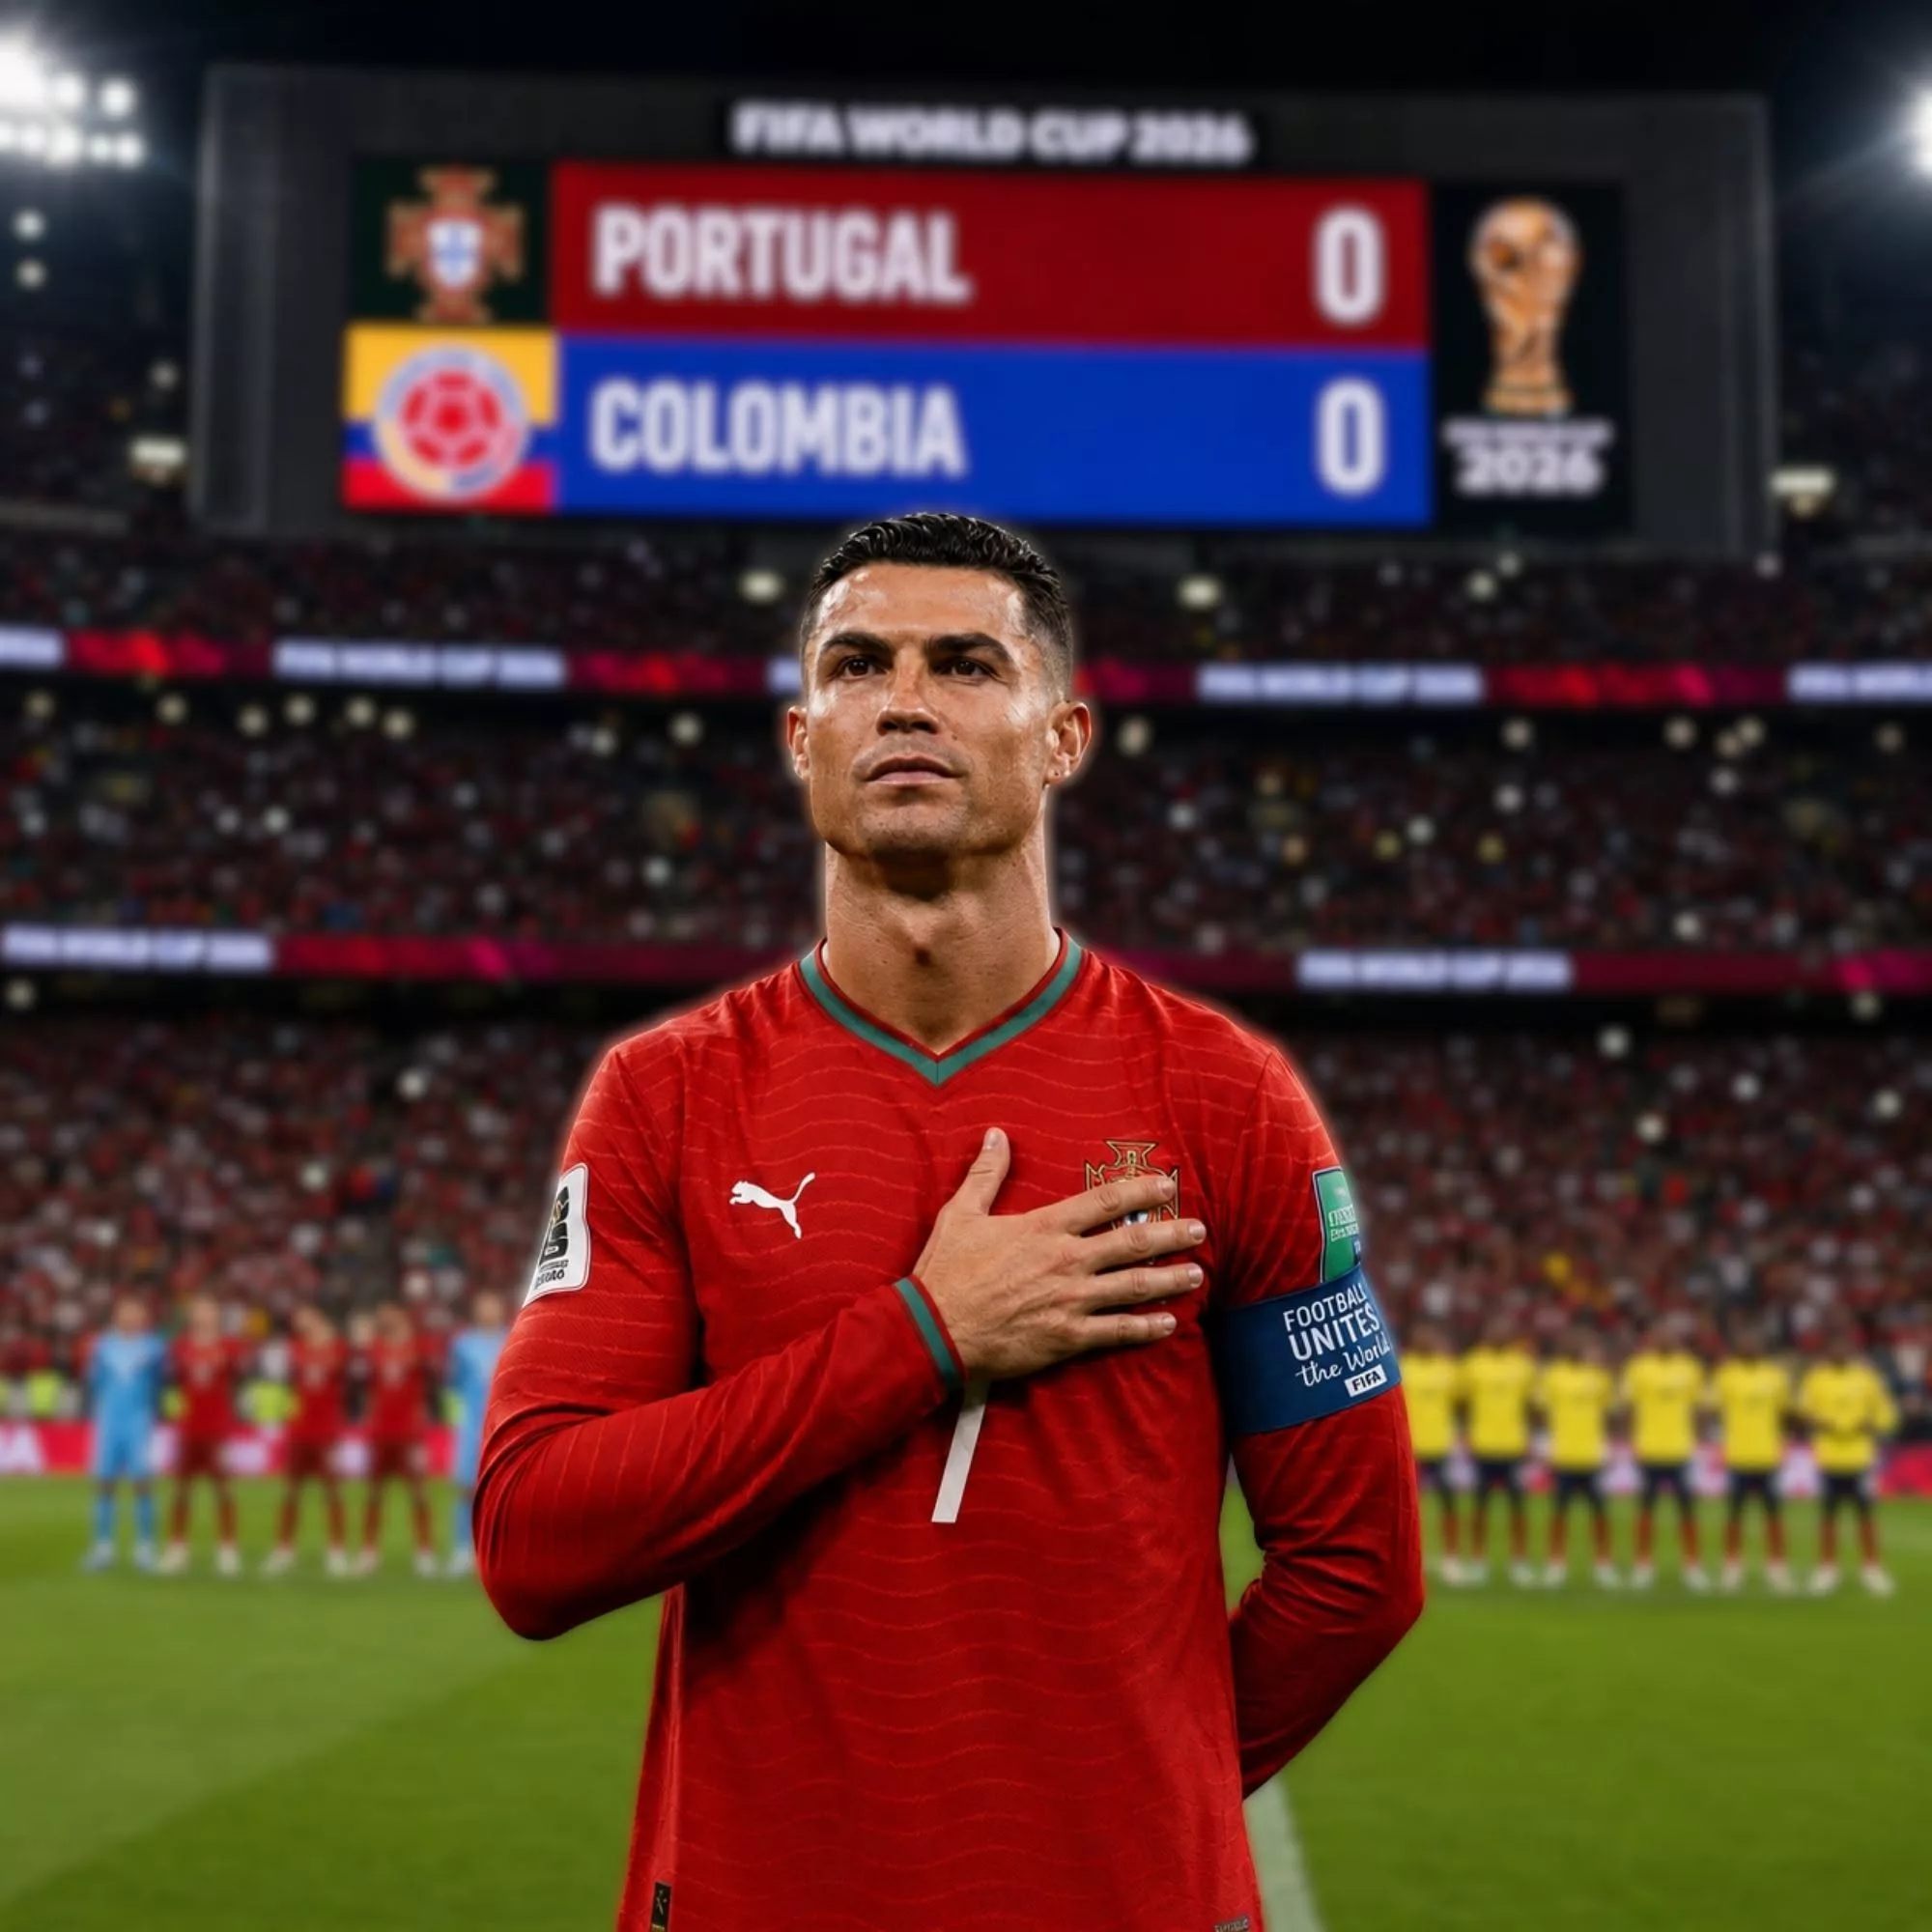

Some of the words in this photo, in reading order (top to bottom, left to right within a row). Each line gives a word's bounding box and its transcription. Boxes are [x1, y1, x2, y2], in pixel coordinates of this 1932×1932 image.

[731, 103, 843, 155] FIFA
[847, 106, 1025, 159] WORLD
[1030, 110, 1127, 161] CUP
[1130, 112, 1252, 164] 2026
[591, 203, 974, 303] PORTUGAL
[1315, 207, 1385, 324] 0
[589, 379, 965, 475] COLOMBIA
[1316, 380, 1385, 496] 0
[1283, 1283, 1367, 1332] FOOTBALL
[1288, 1302, 1379, 1360] UNITES
[1295, 1360, 1343, 1386] the
[1343, 1331, 1390, 1371] World
[1352, 1371, 1381, 1391] FIFA
